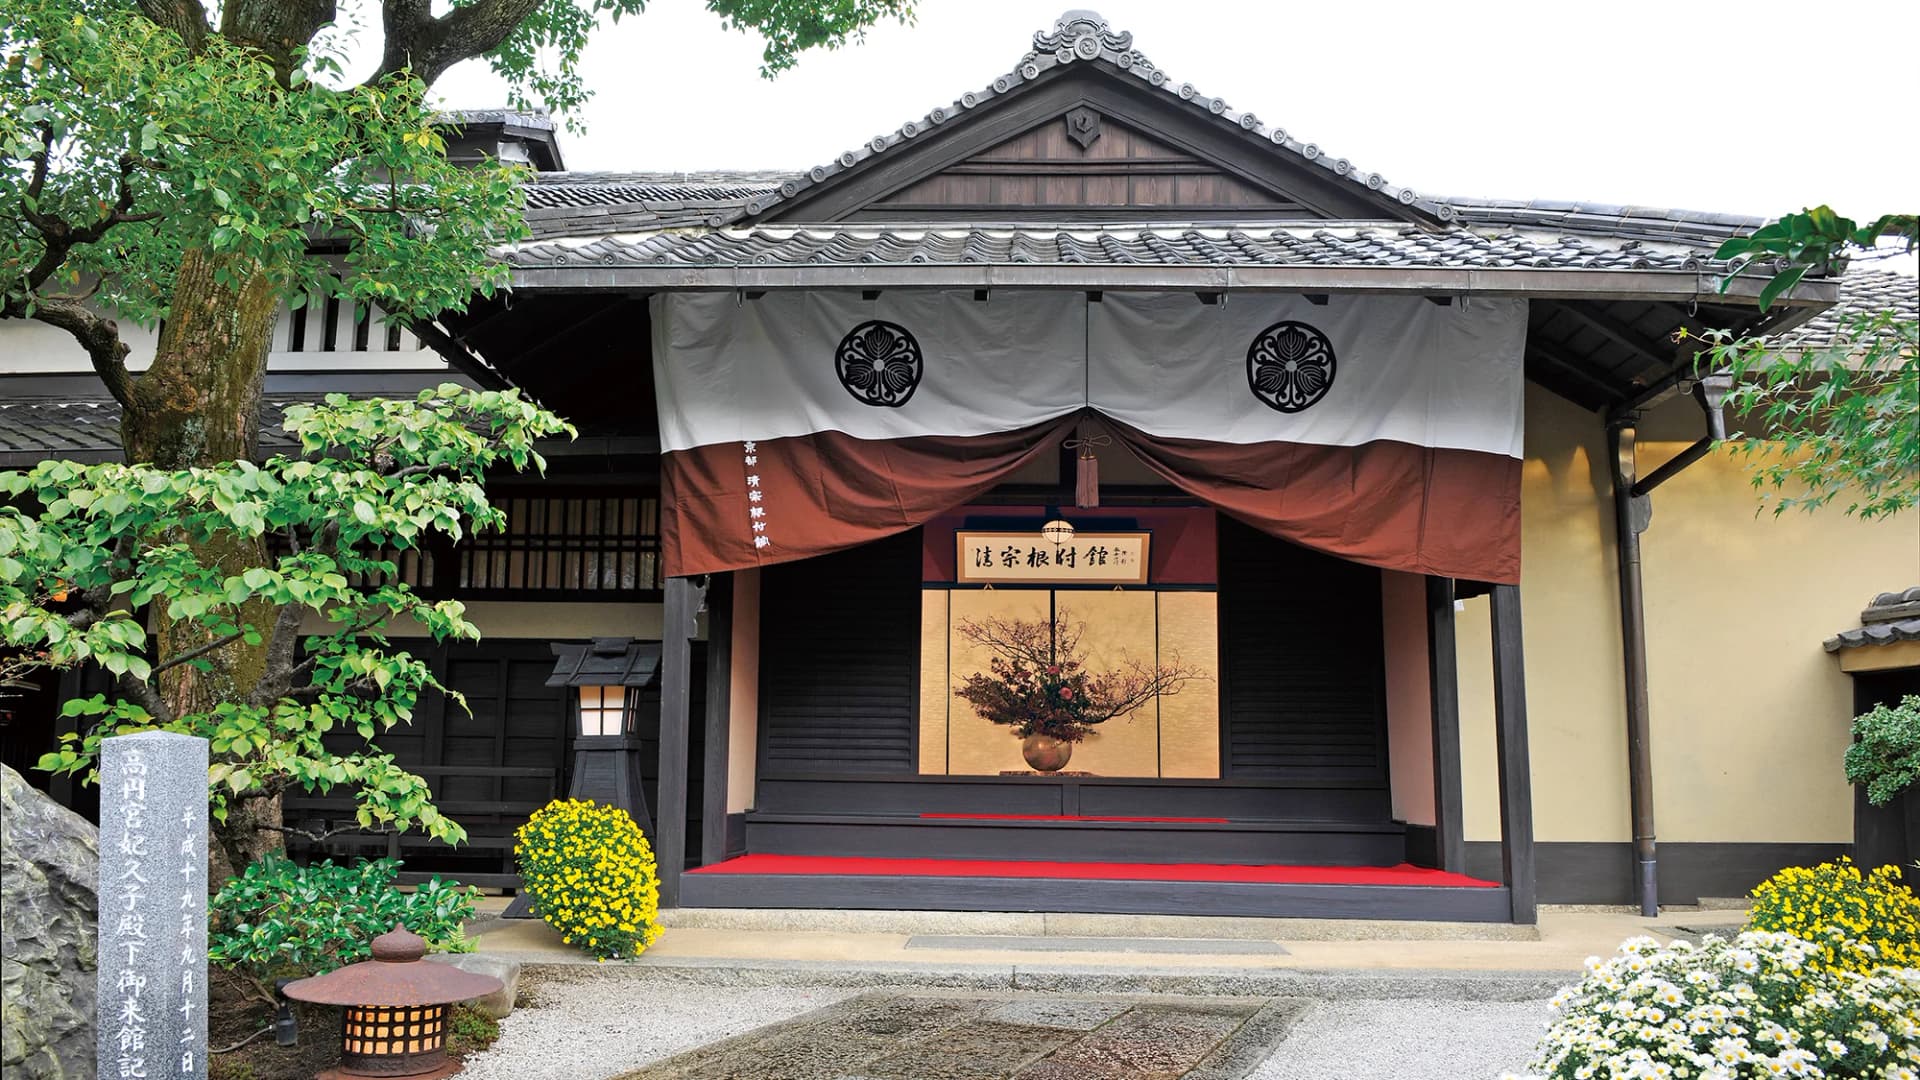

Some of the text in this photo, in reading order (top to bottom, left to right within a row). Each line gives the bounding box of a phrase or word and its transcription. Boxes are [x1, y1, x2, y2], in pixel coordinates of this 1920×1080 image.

[744, 441, 757, 466] 京都
[179, 807, 197, 1072] 平成十九年九月十二日
